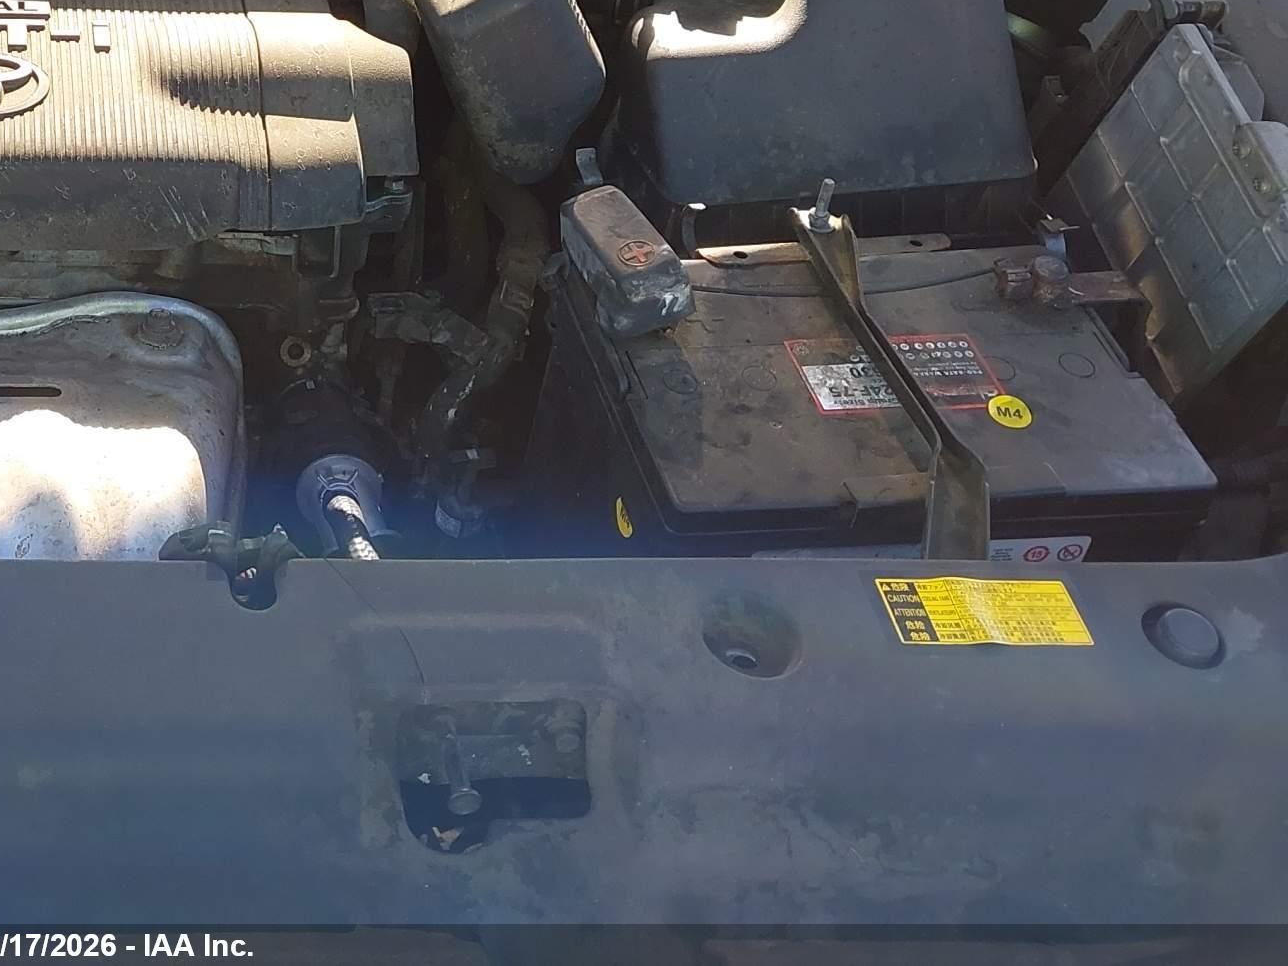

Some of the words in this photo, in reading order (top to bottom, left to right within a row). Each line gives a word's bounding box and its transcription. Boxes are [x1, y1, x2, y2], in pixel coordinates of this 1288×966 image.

[996, 405, 1024, 420] M4
[887, 594, 920, 603] CAUTION
[894, 608, 928, 617] ATTENTION
